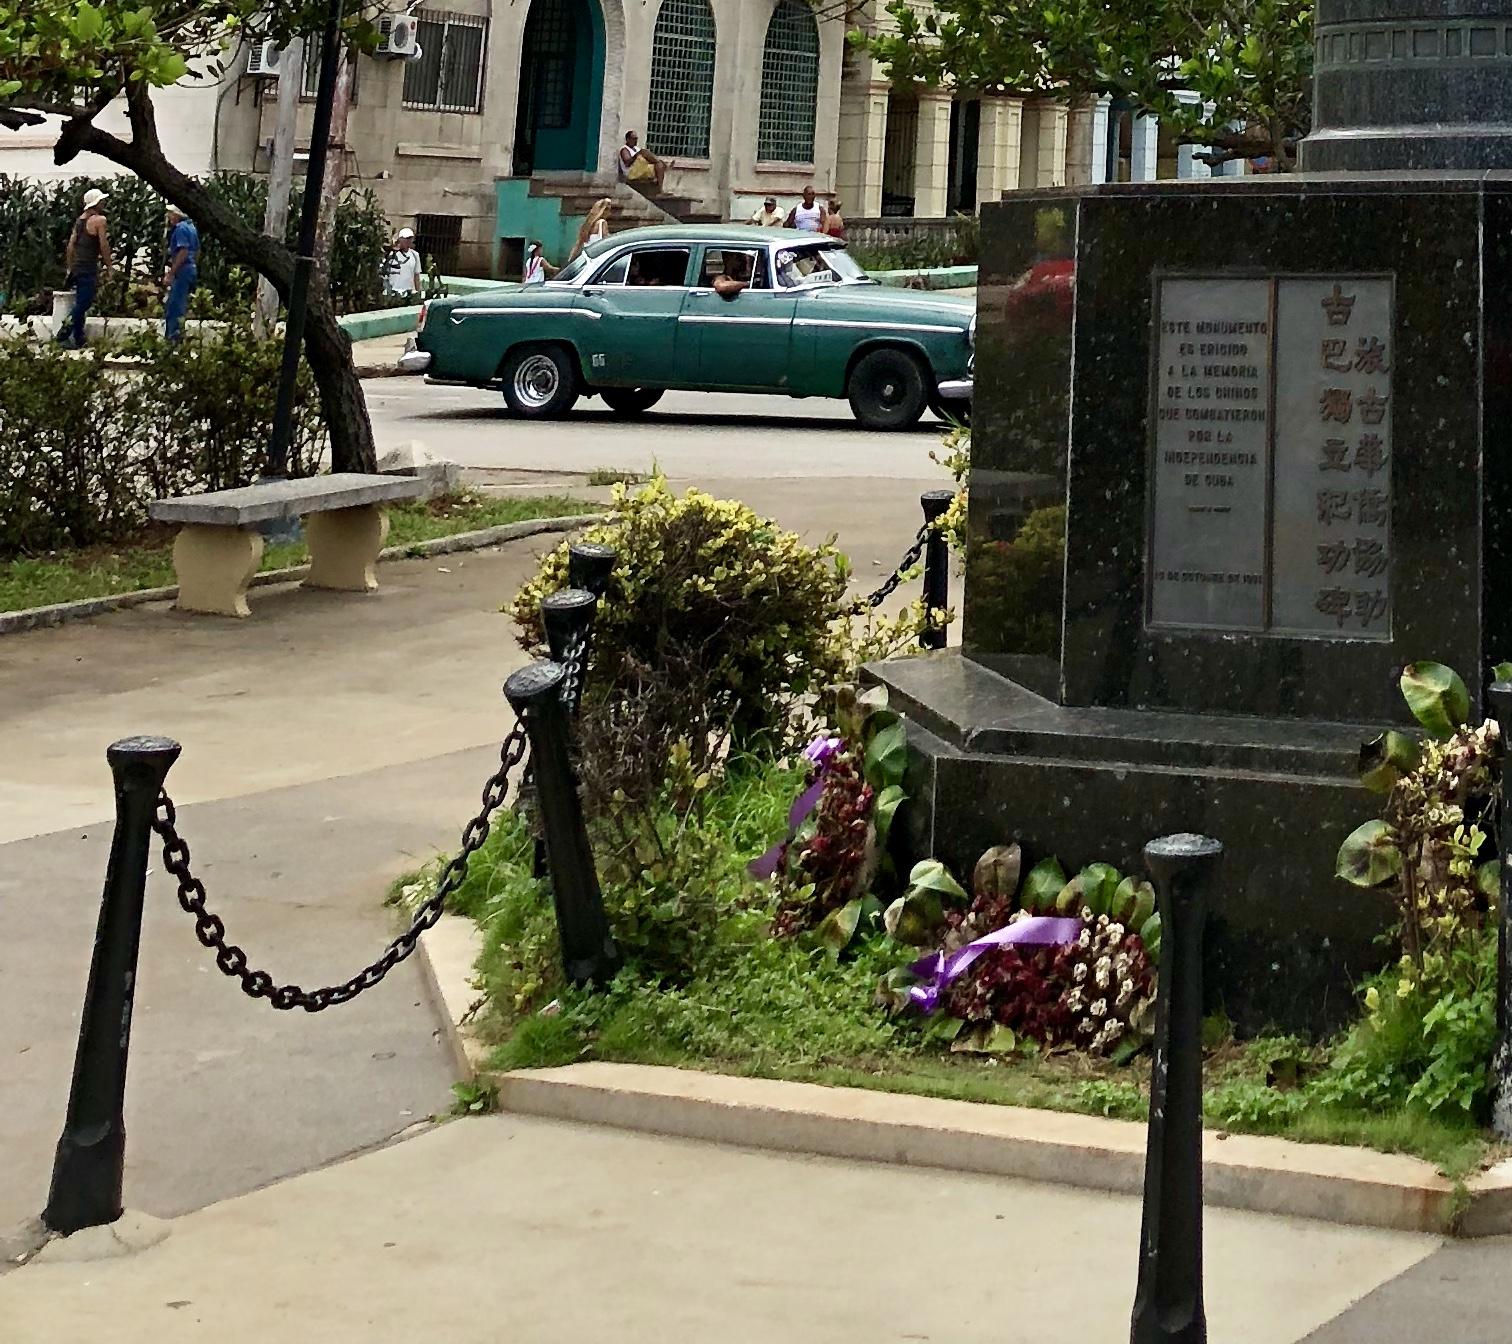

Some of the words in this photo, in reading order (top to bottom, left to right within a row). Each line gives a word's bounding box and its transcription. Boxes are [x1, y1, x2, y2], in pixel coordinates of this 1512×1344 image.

[1162, 321, 1190, 334] ESTE
[1196, 321, 1267, 334] MONUMENTO
[1179, 343, 1194, 356] ES
[1200, 343, 1248, 356] ERIGIDO
[1168, 365, 1174, 377] A
[1182, 365, 1197, 377] LA
[1204, 365, 1258, 378] MEMORIA
[1167, 386, 1182, 399] DE
[1188, 386, 1211, 399] LOS
[1215, 387, 1258, 399] CHINOS
[1159, 408, 1180, 421] QUE
[1186, 408, 1265, 421] COMBATIERON
[1188, 430, 1212, 442] POR
[1217, 431, 1233, 443] LA
[1164, 451, 1257, 465] INDEPENDENCIA
[1184, 473, 1199, 486] DE
[1205, 474, 1234, 487] CUBA
